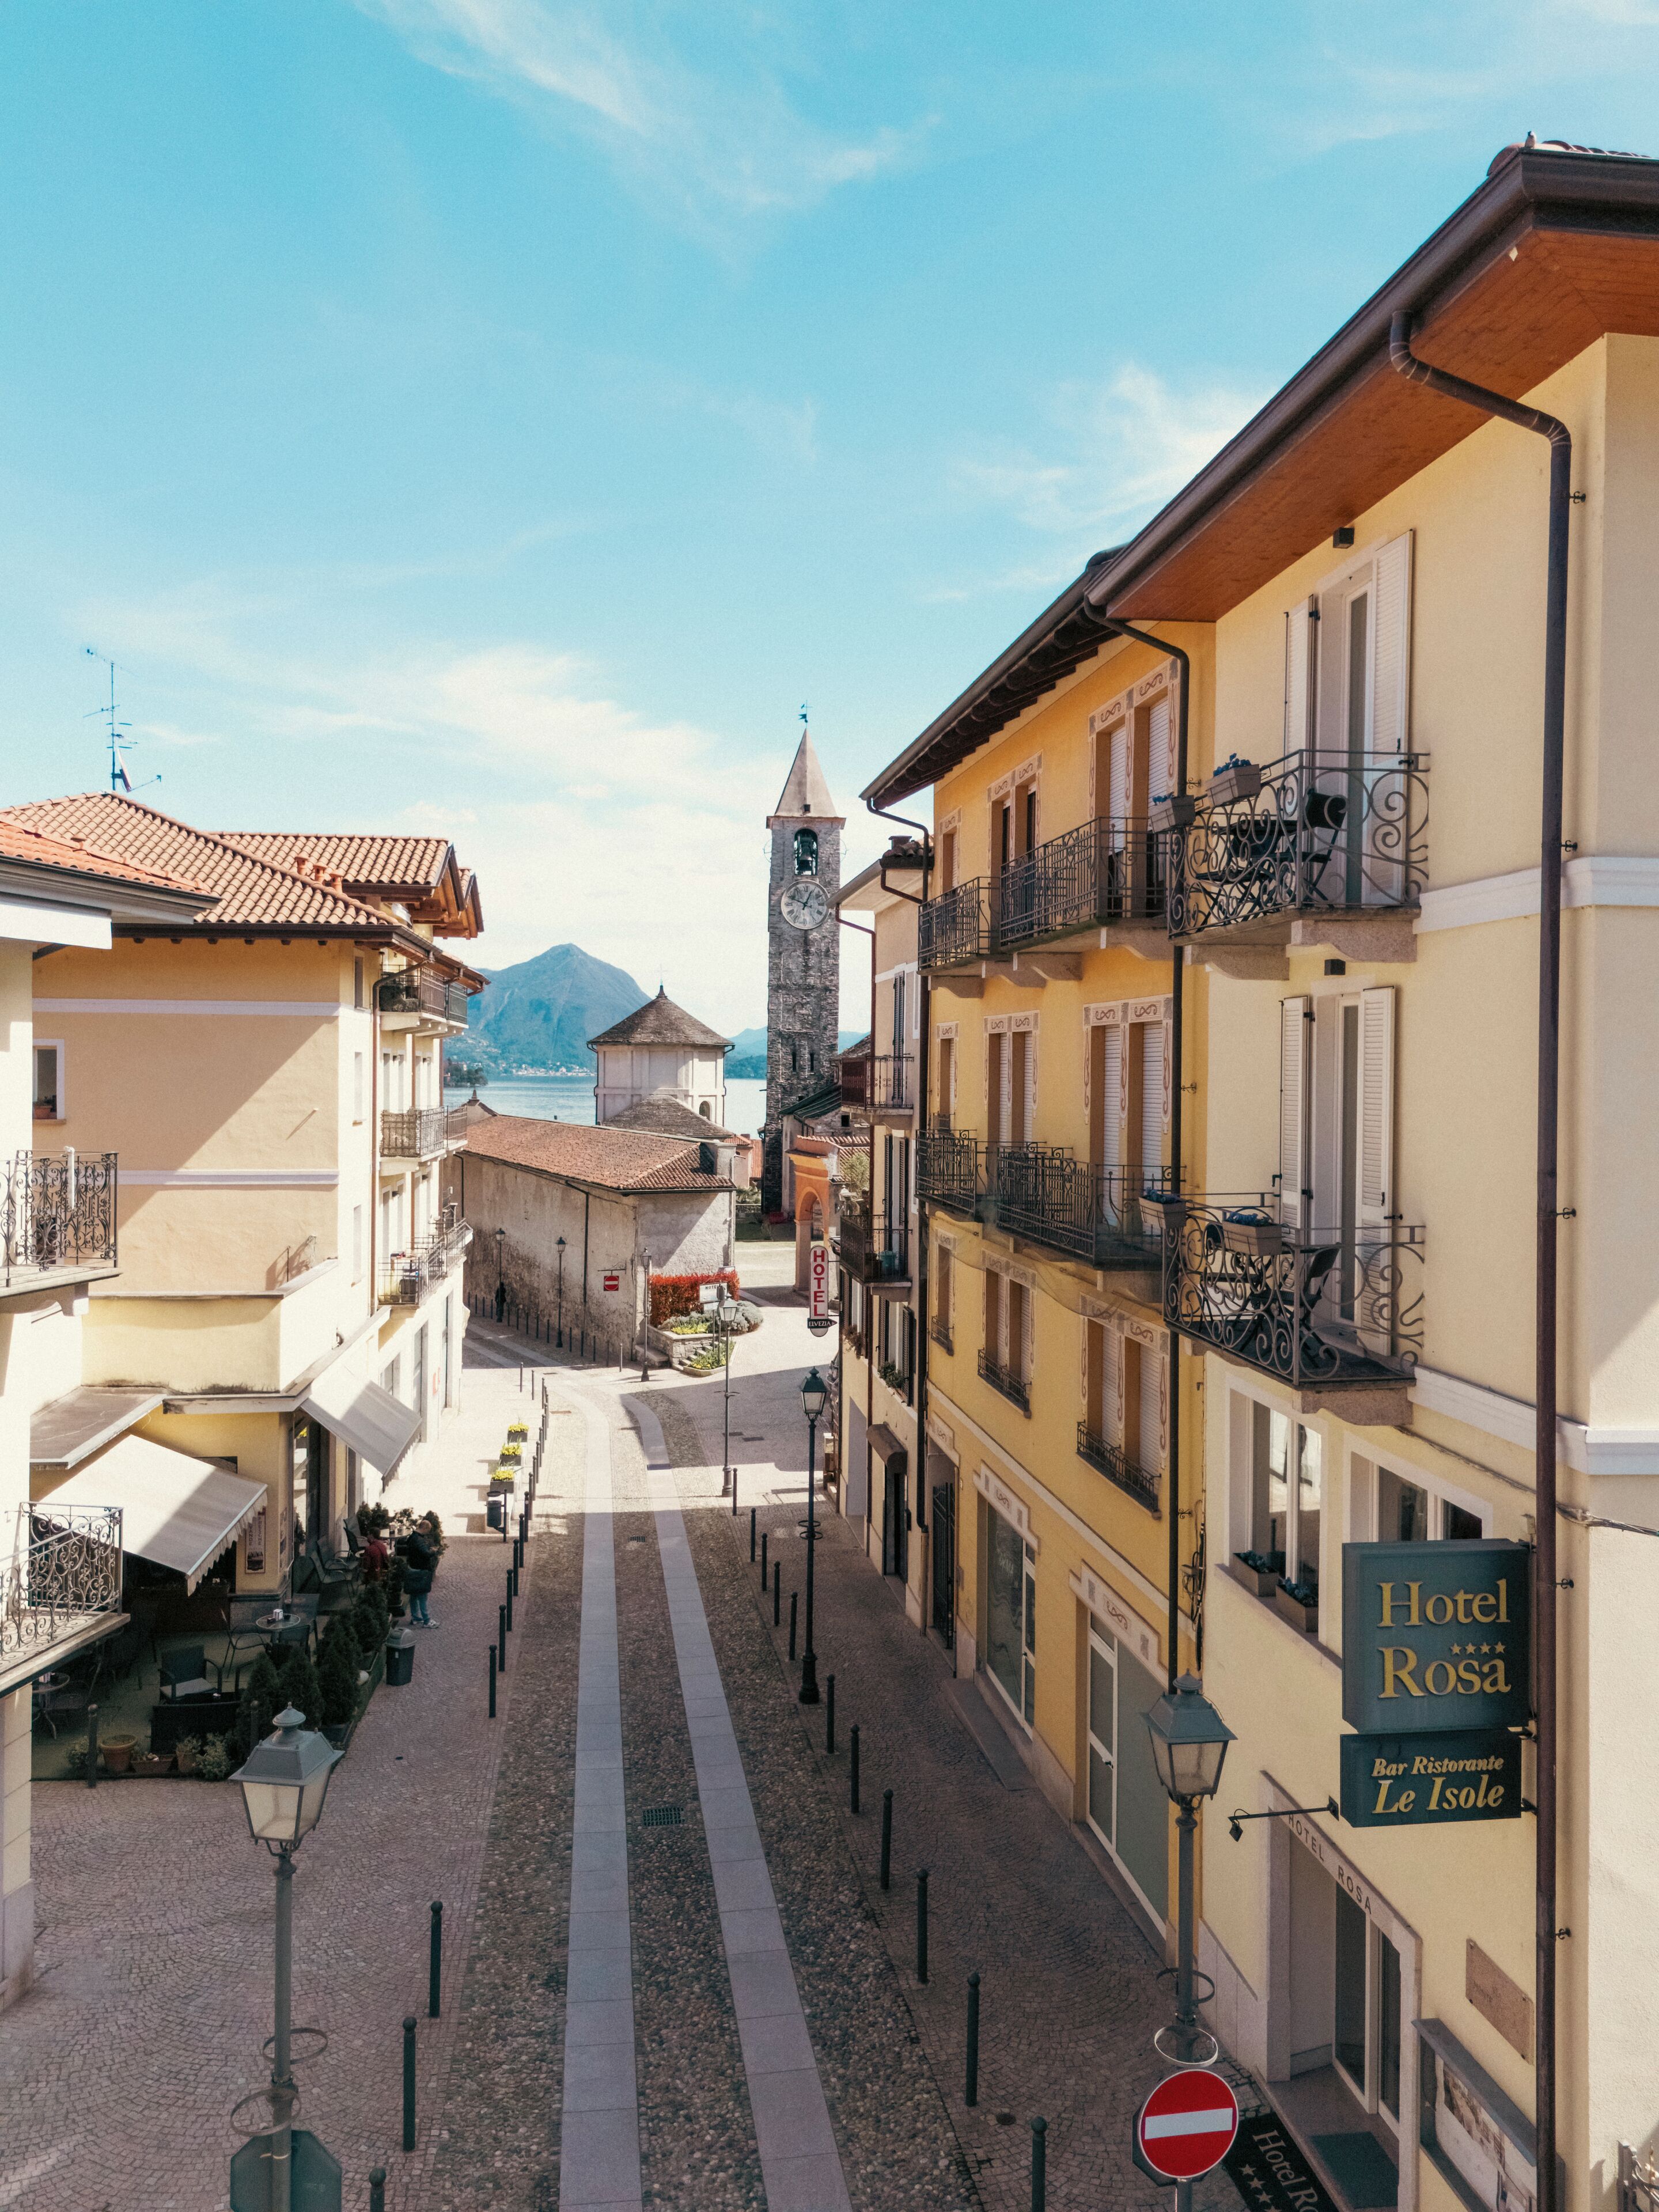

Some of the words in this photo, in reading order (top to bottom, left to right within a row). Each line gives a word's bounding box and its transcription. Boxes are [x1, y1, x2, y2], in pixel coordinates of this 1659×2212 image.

[813, 1250, 825, 1317] HOTEL
[1377, 1578, 1510, 1627] Hotel
[1378, 1646, 1511, 1699] Rosa
[1372, 1758, 1407, 1778] Bar
[1411, 1755, 1504, 1775] Ristorante
[1372, 1779, 1415, 1813] Le
[1426, 1774, 1505, 1810] Isole
[1289, 1814, 1324, 1862] HOTEL
[1338, 1865, 1372, 1915] ROSA
[1252, 2130, 1306, 2187] Hotel
